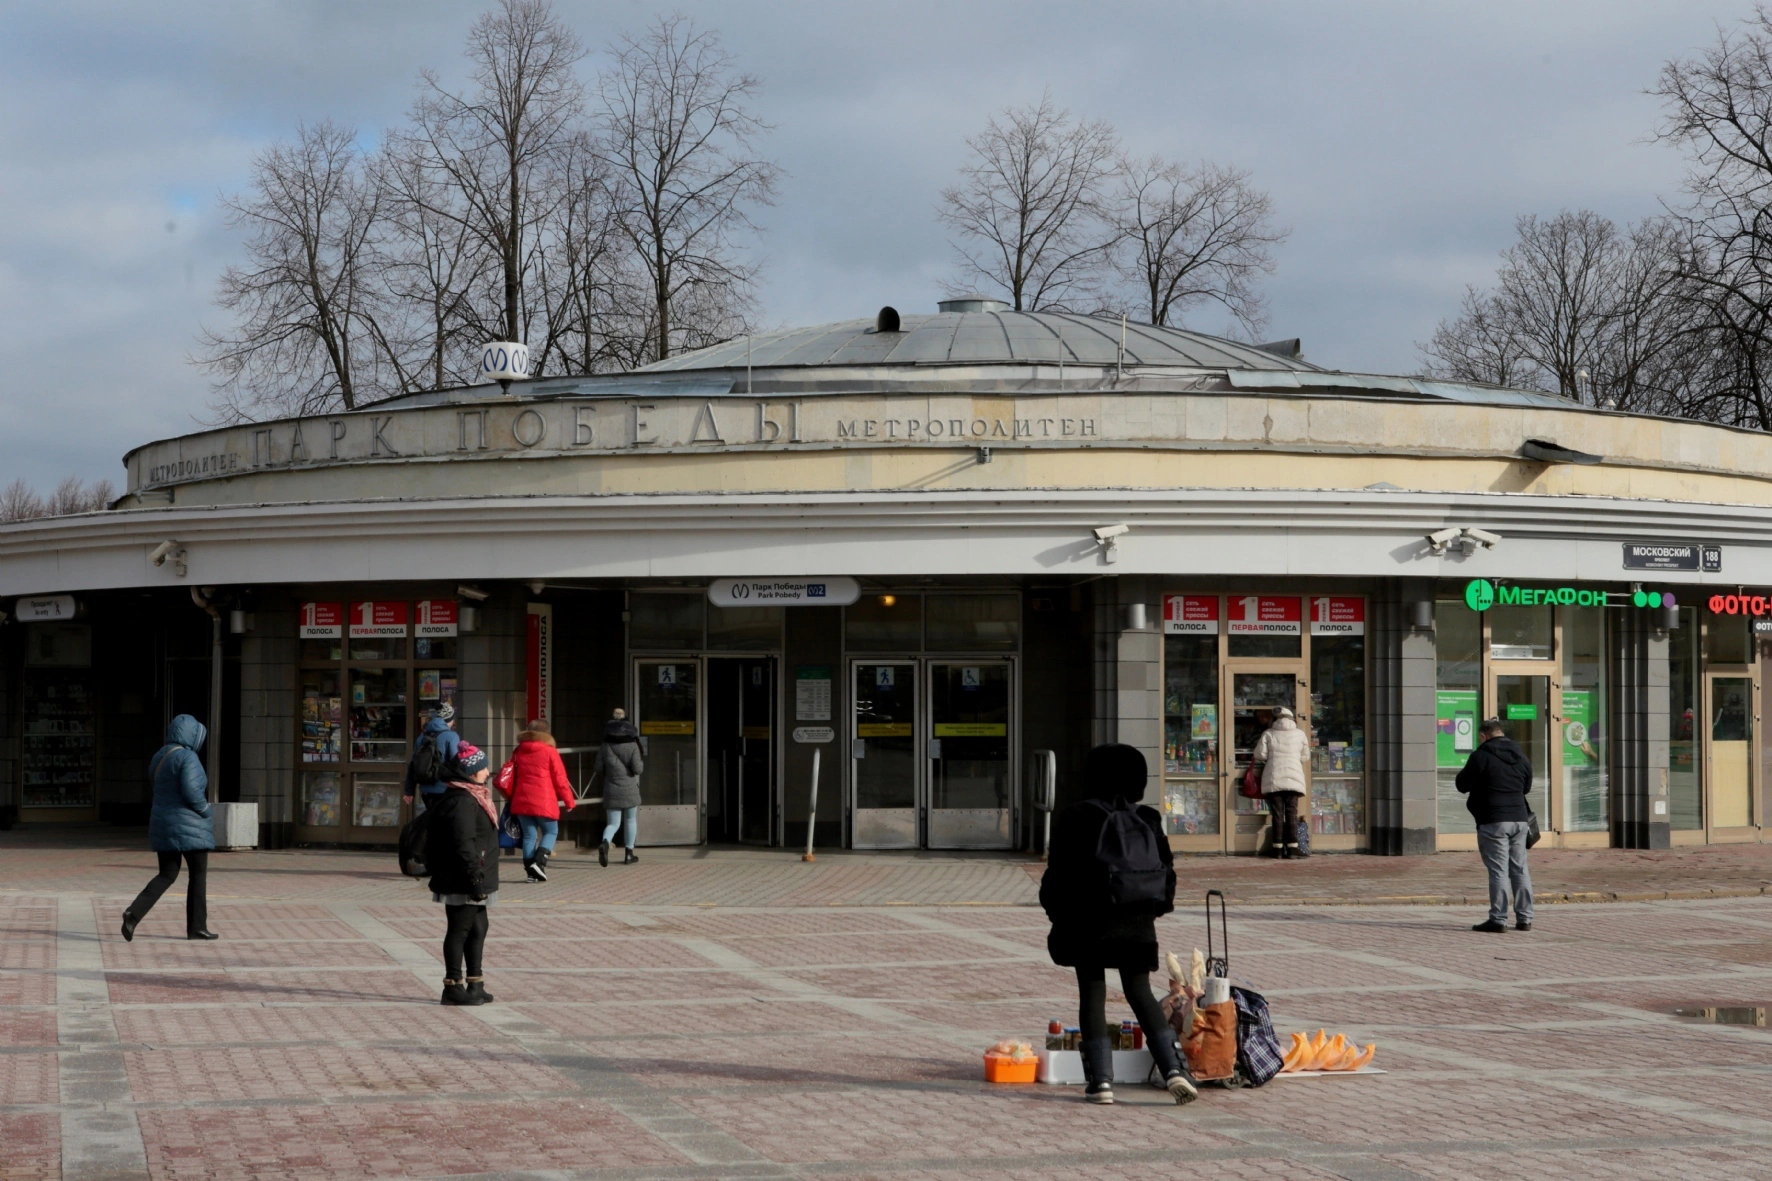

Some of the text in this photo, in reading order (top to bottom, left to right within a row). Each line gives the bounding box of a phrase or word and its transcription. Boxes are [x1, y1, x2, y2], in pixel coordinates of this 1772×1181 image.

[837, 417, 1098, 438] МЕТРОПОЛИТЕН
[252, 401, 803, 467] ПАРК ПОБЕДЫ
[150, 452, 239, 483] МЕТРОПОЛИТЕН
[1632, 546, 1691, 558] МОСКОВСКИЙ
[1705, 551, 1719, 562] 188
[752, 583, 773, 591] Парк
[774, 582, 806, 590] Победы
[775, 591, 801, 599] Pobedy
[1709, 594, 1772, 616] ФОТО-
[422, 626, 449, 634] ПОЛОСА
[1231, 624, 1297, 632] ПЕРВАЯПОЛОСА
[1319, 624, 1353, 632] ПОЛОСА
